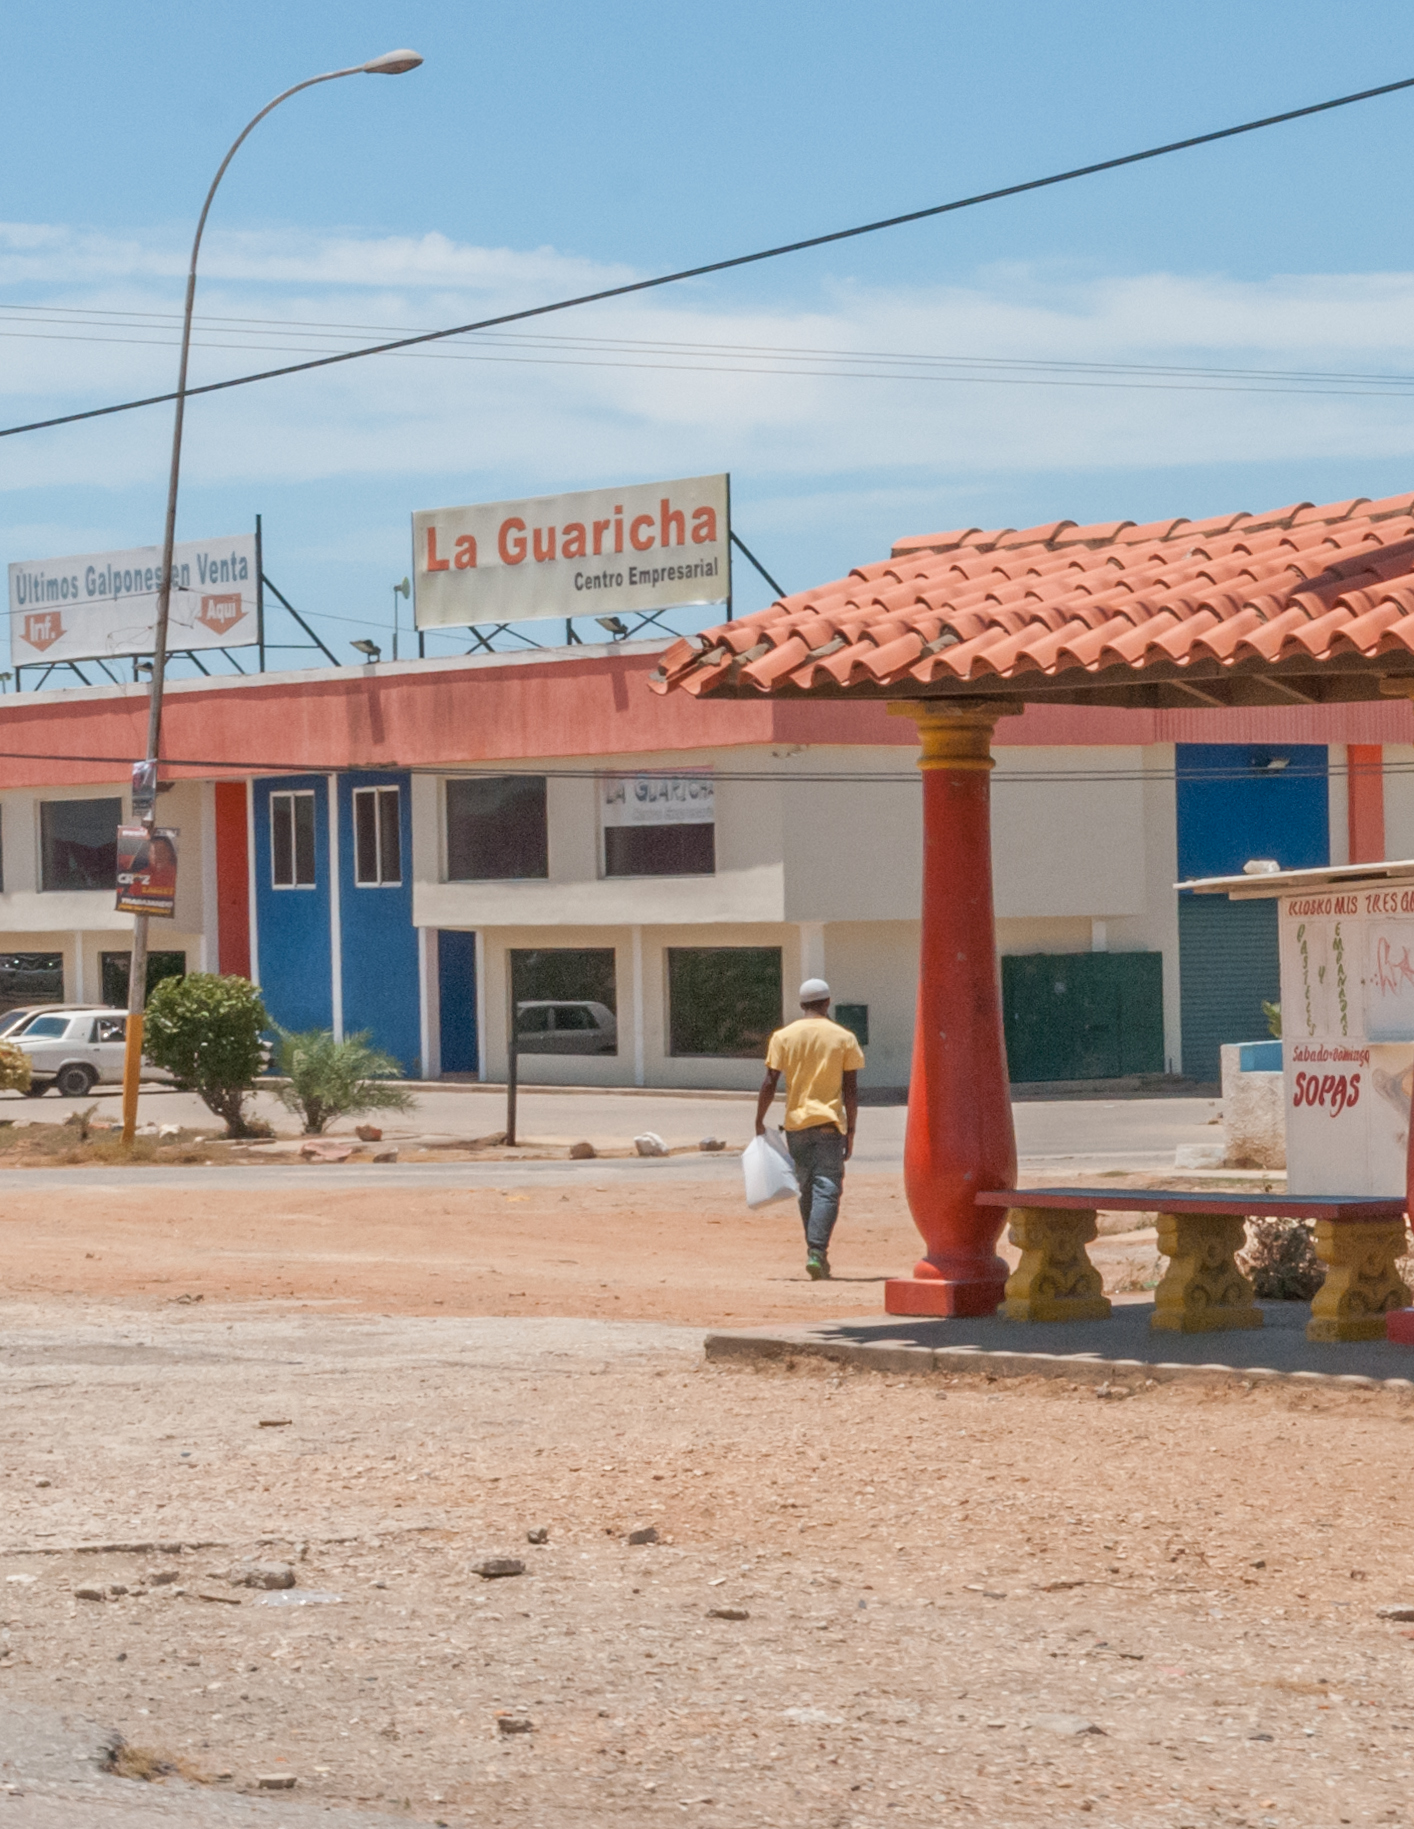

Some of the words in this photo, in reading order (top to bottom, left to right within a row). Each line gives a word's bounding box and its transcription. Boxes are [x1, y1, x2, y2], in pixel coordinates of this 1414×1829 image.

[427, 526, 478, 573] La
[498, 498, 718, 566] Guaricha
[85, 563, 164, 598] Galpones
[172, 562, 191, 588] en
[196, 551, 249, 586] Venta
[574, 572, 623, 592] Centro
[629, 557, 719, 588] Empresarial
[30, 614, 57, 643] Inf.
[1288, 898, 1332, 916] KIOSKO
[1334, 896, 1359, 915] MIS
[1366, 893, 1398, 914] TRES
[1293, 1071, 1361, 1118] SOPAS
